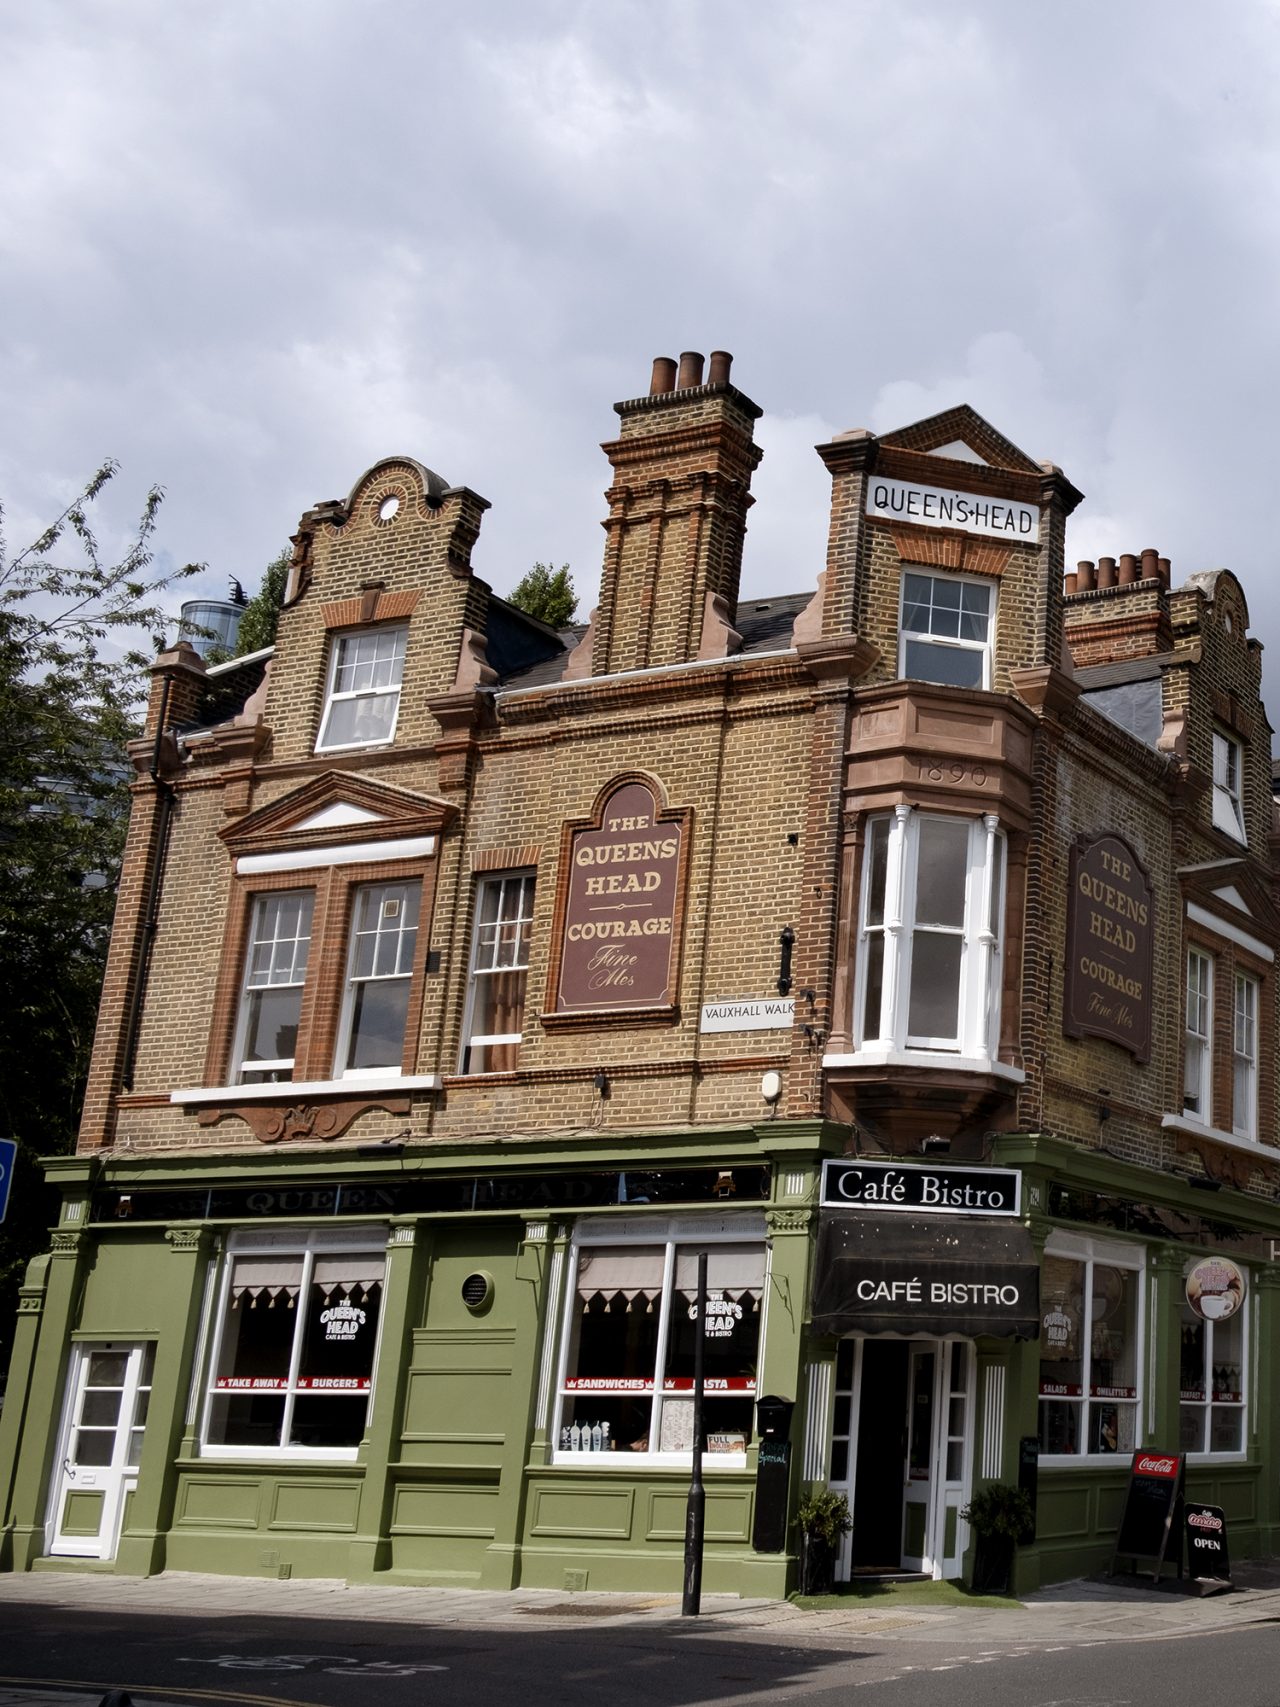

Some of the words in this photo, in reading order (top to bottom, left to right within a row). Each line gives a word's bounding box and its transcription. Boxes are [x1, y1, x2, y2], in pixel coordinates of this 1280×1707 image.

[874, 485, 969, 523] QUEEN'S
[975, 502, 1032, 534] HEAD
[917, 758, 987, 787] 1890
[608, 816, 650, 833] THE
[576, 839, 678, 867] QUEENS
[1101, 849, 1132, 883] THE
[585, 871, 661, 896] HEAD
[1079, 872, 1149, 927] QUEENS
[567, 917, 672, 942] COURAGE
[1089, 911, 1136, 954] HEAD
[587, 943, 639, 971] Fine
[1080, 956, 1143, 1001] COURAGE
[705, 1004, 761, 1019] VAUXHALL
[764, 1002, 794, 1016] WALK
[1086, 991, 1112, 1017] Fine
[838, 1170, 906, 1202] Café
[919, 1176, 1004, 1208] Bistro
[857, 1277, 922, 1302] CAFÉ
[930, 1282, 1020, 1306] BISTRO
[320, 1306, 366, 1325] QUEEN'S
[326, 1320, 359, 1334] HEAD
[1048, 1326, 1068, 1341] HEAD
[227, 1378, 252, 1388] TAKE
[252, 1378, 281, 1388] AWAY
[311, 1378, 359, 1389] BURGERS
[577, 1379, 645, 1389] SANDWICHES
[1043, 1384, 1068, 1395] SALADS
[1096, 1386, 1129, 1398] OMELETTES
[708, 1435, 730, 1444] FULL
[1193, 1537, 1221, 1551] OPEN
